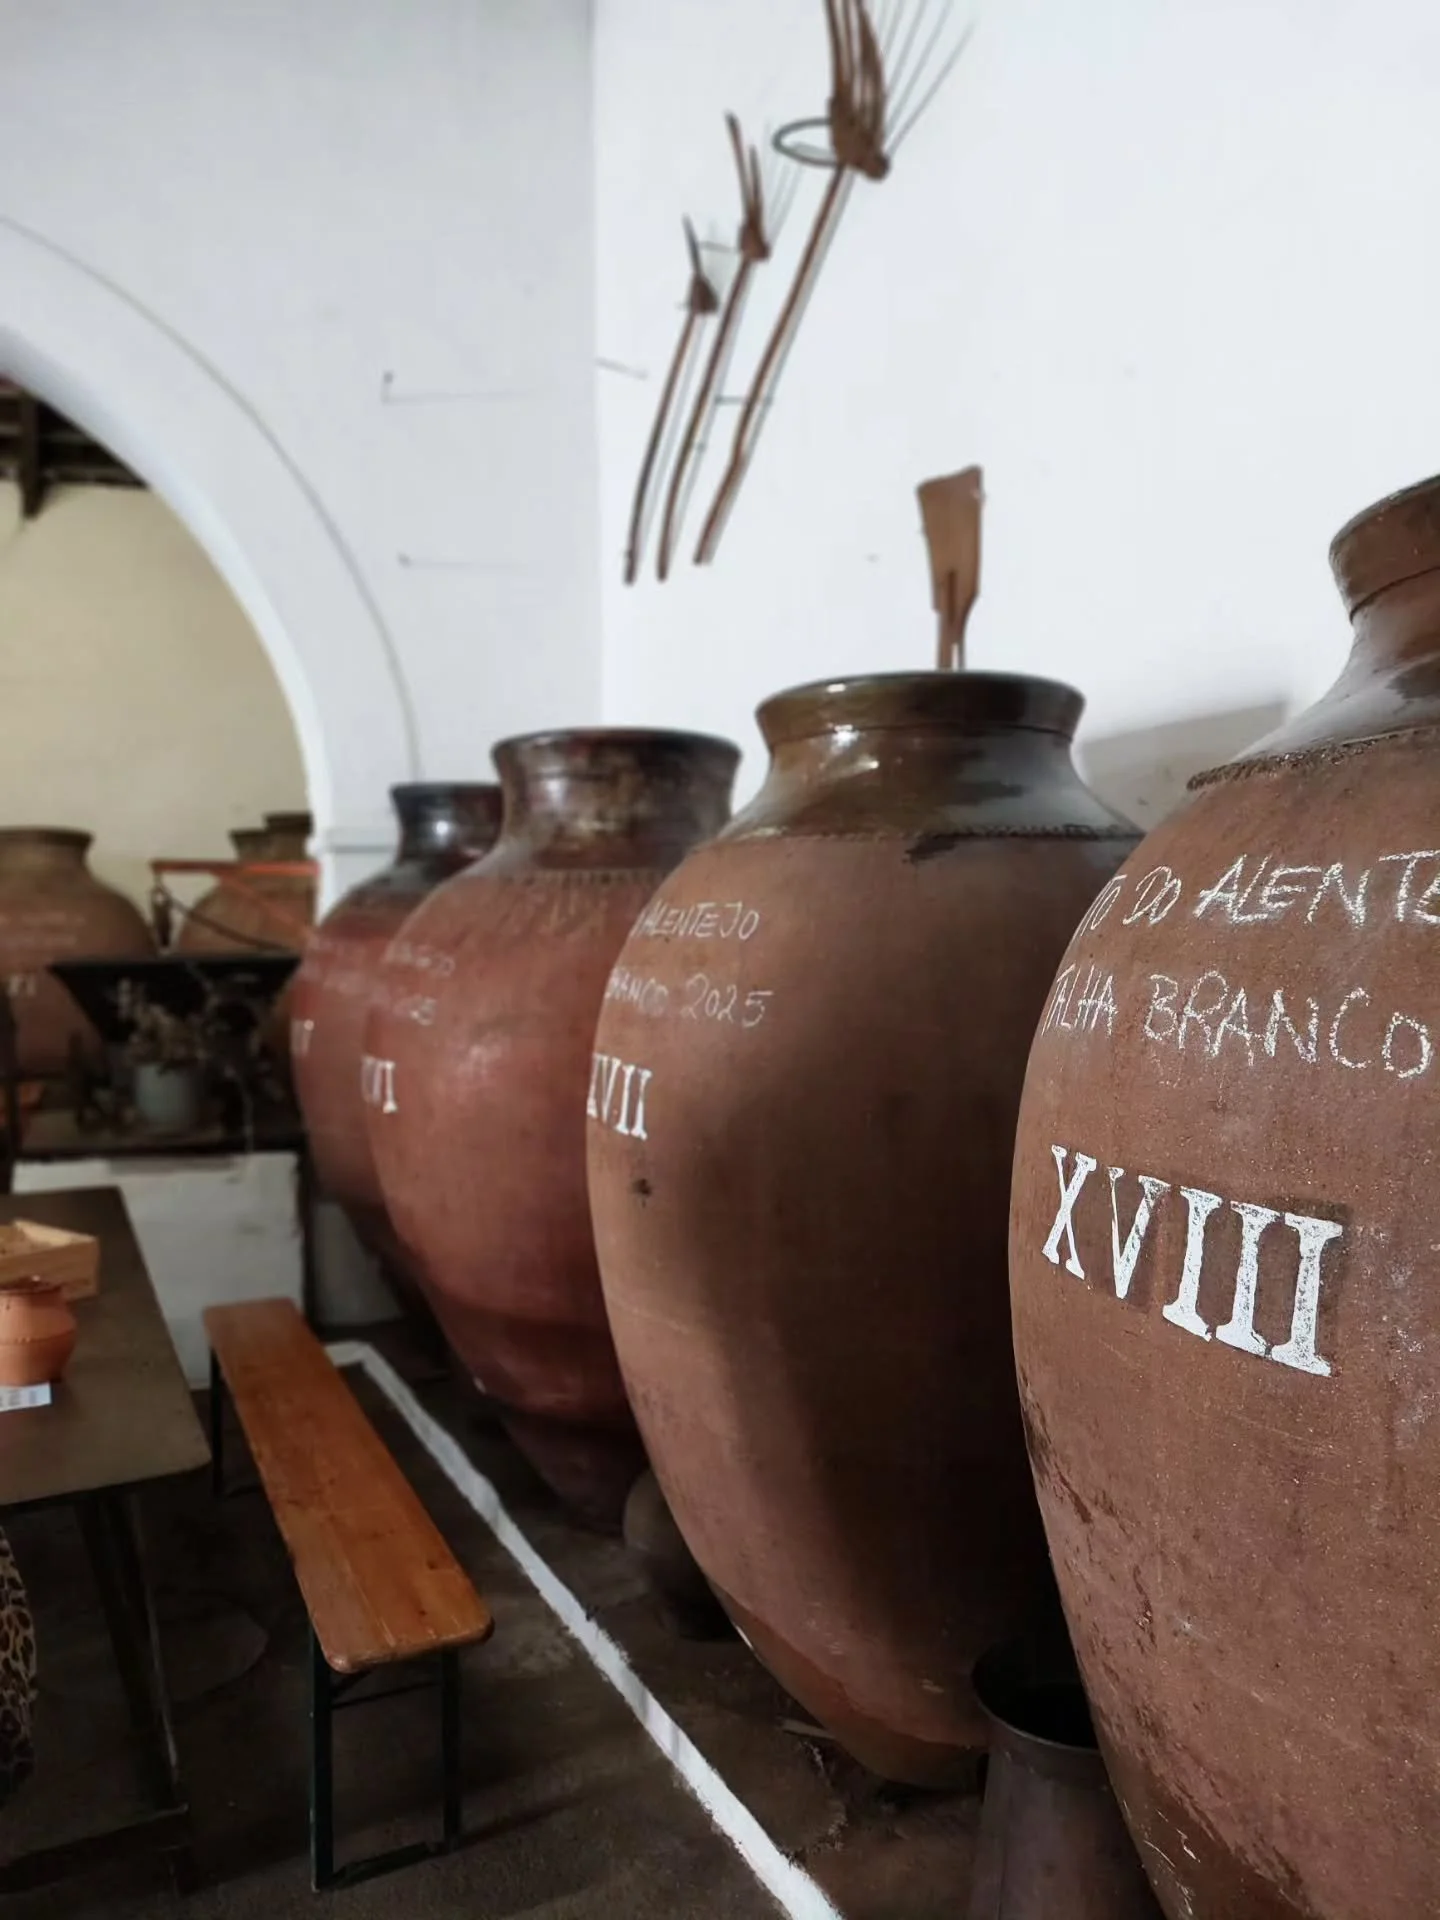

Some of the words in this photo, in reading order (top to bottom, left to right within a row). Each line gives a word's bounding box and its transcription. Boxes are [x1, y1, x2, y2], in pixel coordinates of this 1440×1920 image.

[1122, 866, 1182, 925] DO
[681, 972, 774, 1028] 2025
[1144, 970, 1434, 1079] BRANCO
[1042, 1145, 1344, 1377] XVIII
